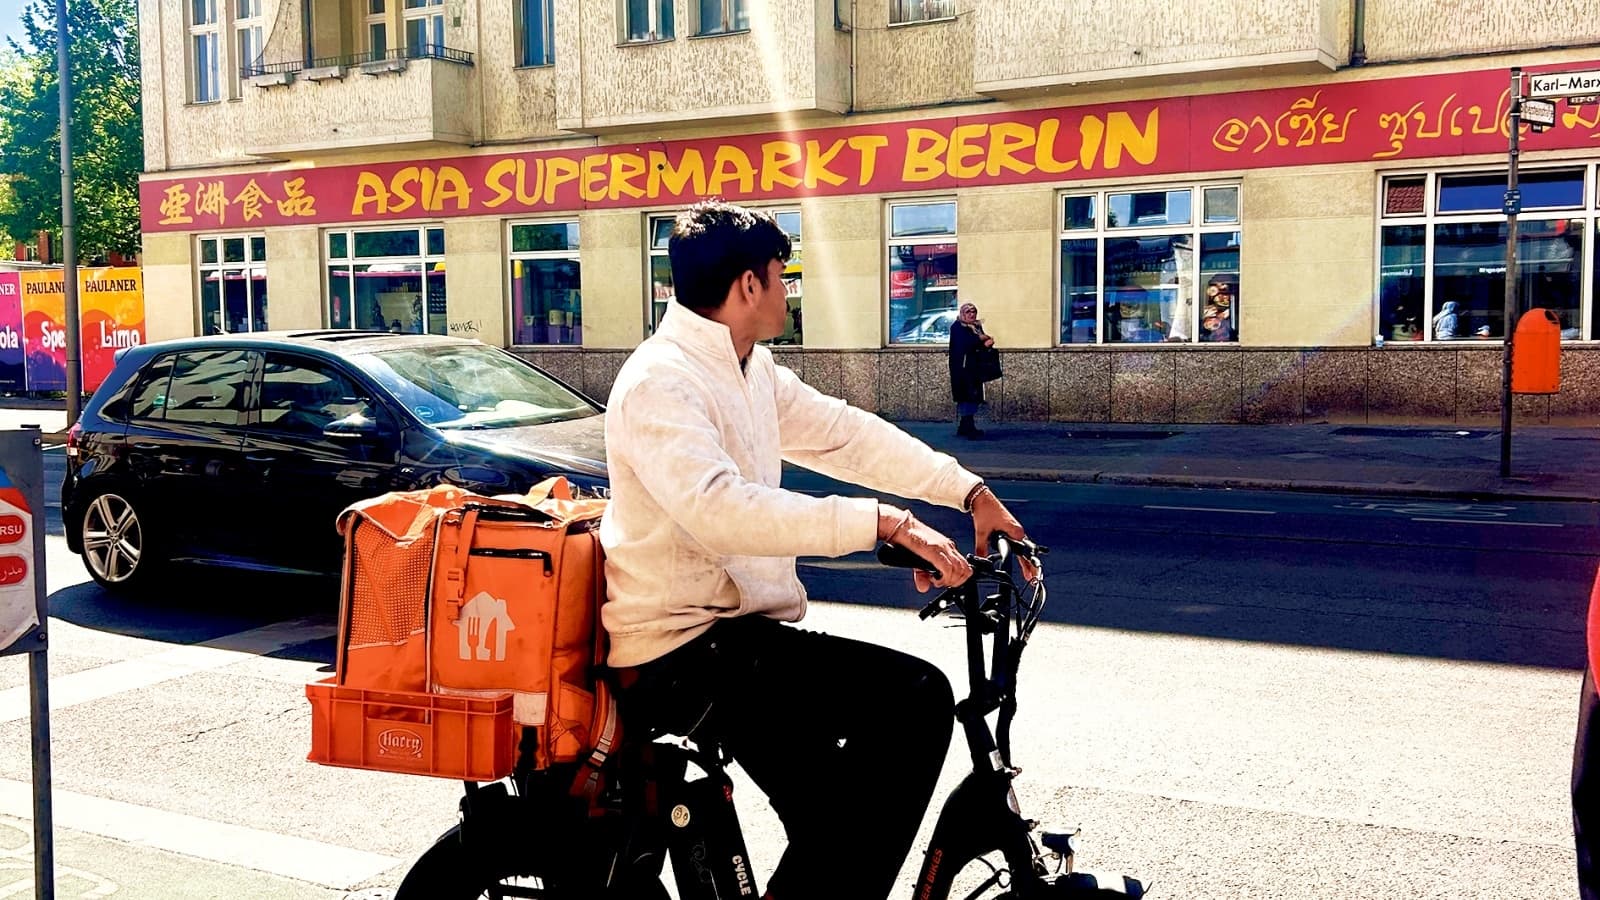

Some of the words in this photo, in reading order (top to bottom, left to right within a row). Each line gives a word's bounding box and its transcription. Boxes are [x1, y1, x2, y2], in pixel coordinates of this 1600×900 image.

[1533, 76, 1600, 92] Karl-Marx
[352, 166, 472, 215] ASIA
[482, 135, 888, 208] SUPERMARKT
[902, 106, 1159, 182] BERLIN
[26, 281, 65, 294] PAULAN
[85, 279, 137, 293] PAULANER
[41, 320, 66, 352] Spe
[100, 320, 140, 349] Limo
[732, 854, 752, 896] CYCLE
[926, 848, 943, 884] BIKES
